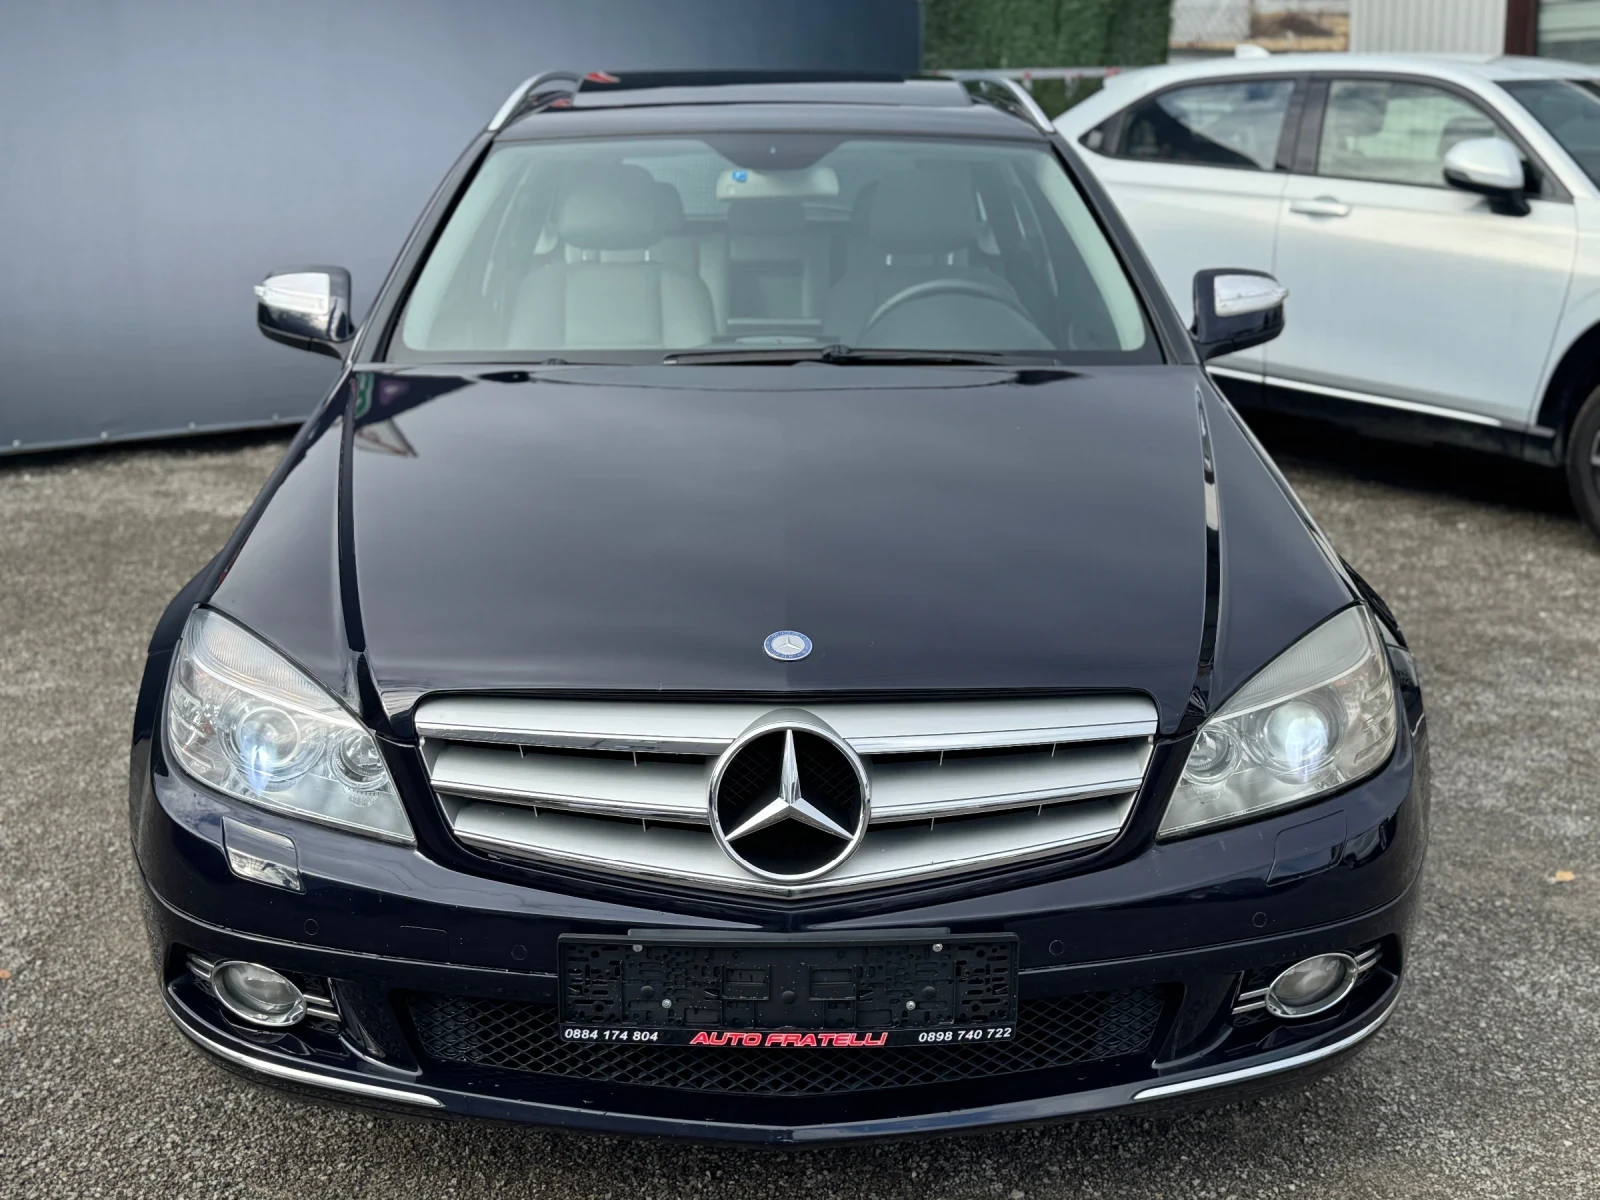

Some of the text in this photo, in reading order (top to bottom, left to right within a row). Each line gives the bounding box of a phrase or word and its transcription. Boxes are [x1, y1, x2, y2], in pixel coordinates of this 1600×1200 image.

[564, 1028, 659, 1041] 0884 174 804
[689, 1031, 889, 1047] AUTO FRATELLI
[918, 1027, 1012, 1042] 0898 740 722
